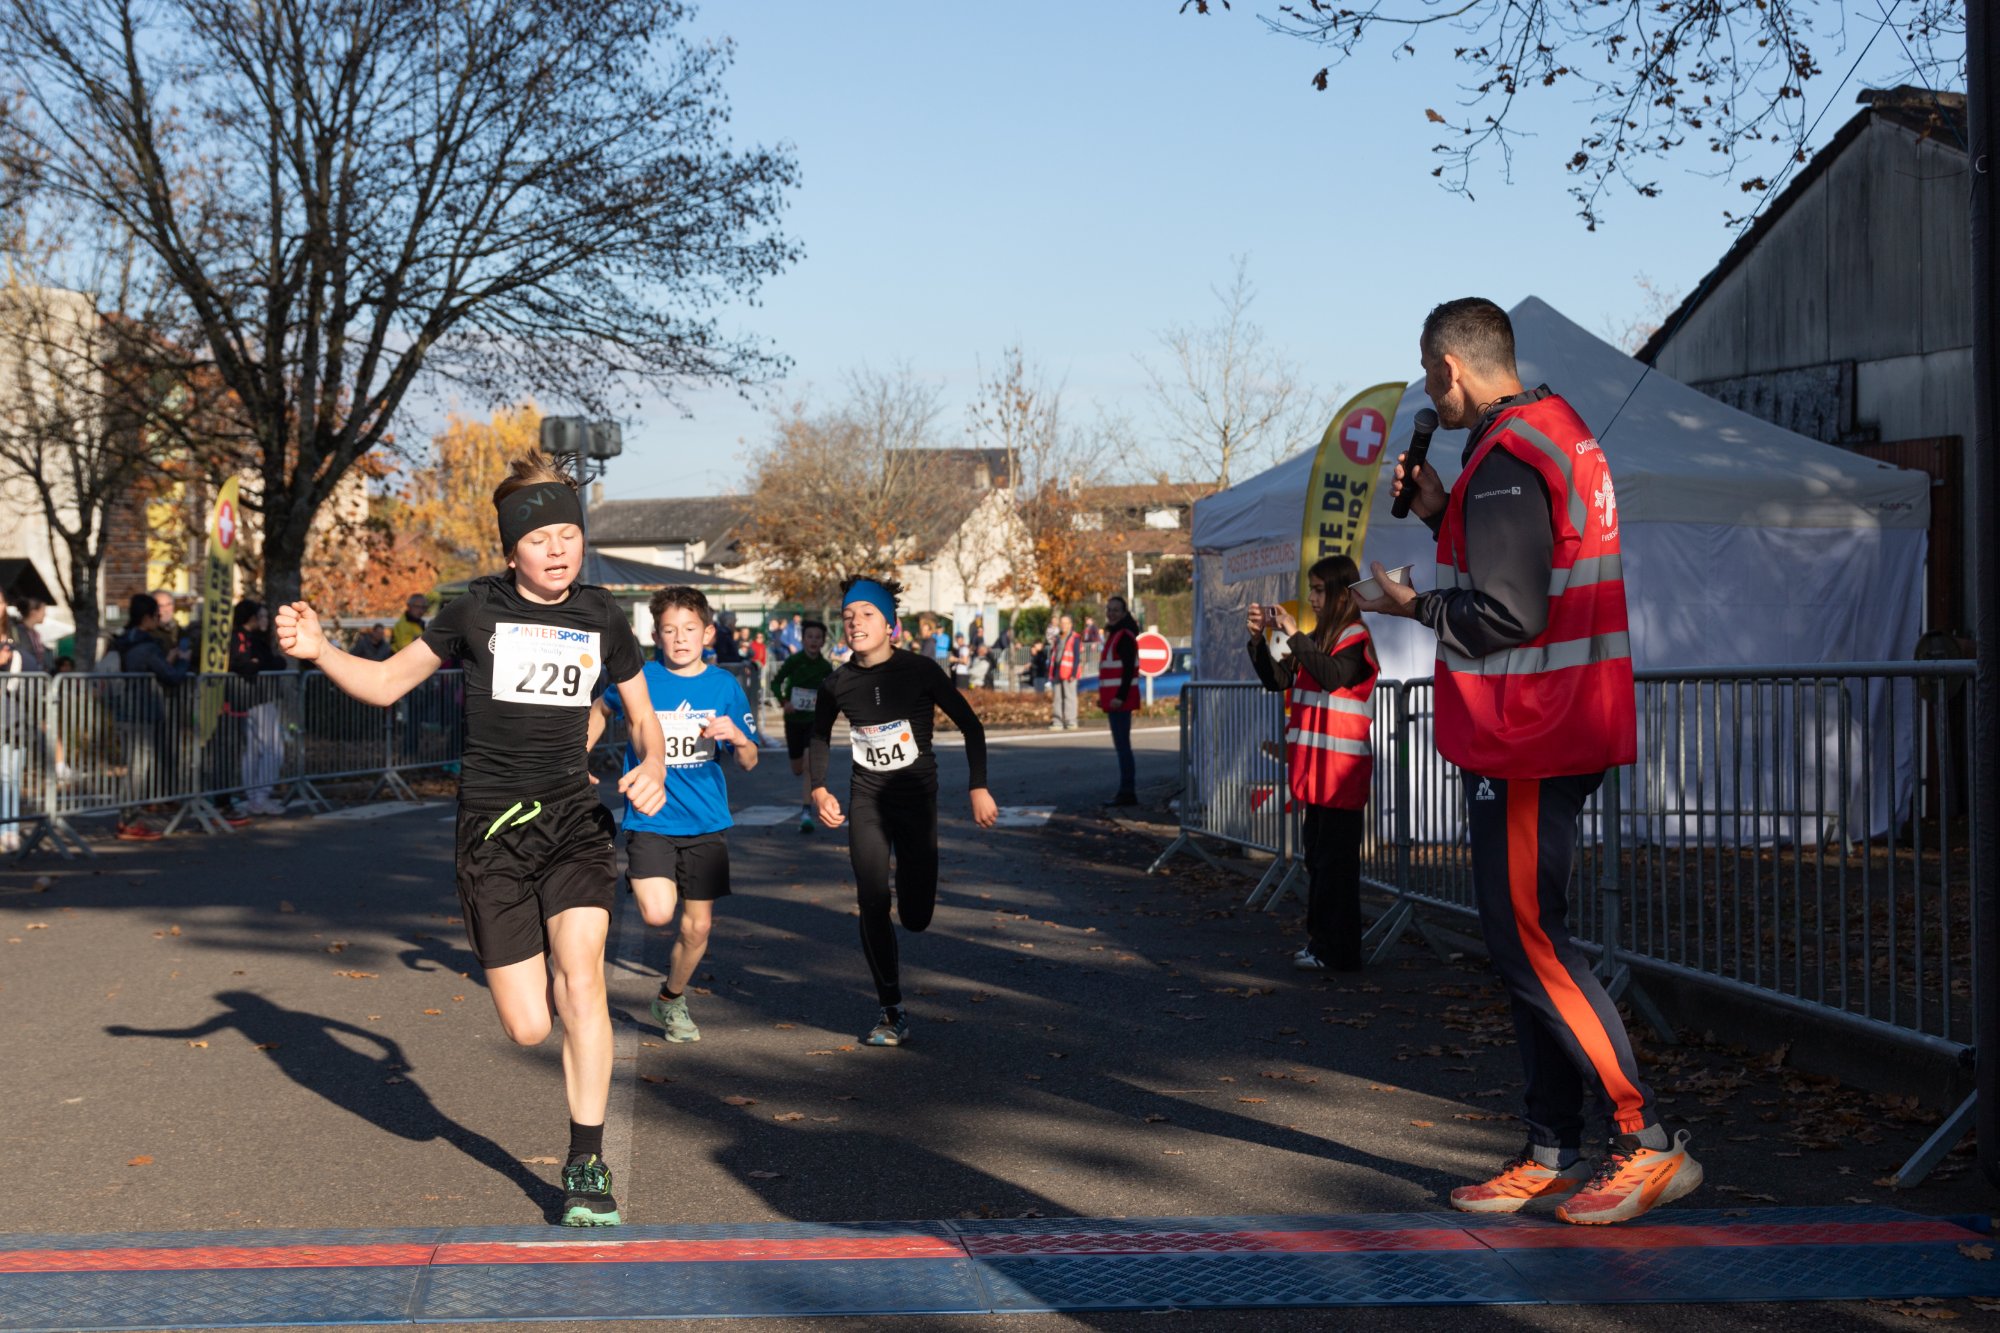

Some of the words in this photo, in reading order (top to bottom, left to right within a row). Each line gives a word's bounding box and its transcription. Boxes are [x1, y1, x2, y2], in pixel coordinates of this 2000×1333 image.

[1322, 472, 1347, 513] DE
[1228, 551, 1248, 574] POSTE
[1249, 548, 1261, 569] DE
[1260, 542, 1296, 567] SECOURS
[520, 626, 590, 644] INTERSPORT
[515, 662, 582, 697] 229
[865, 743, 906, 767] 454
[1651, 1162, 1674, 1185] SALOMON
